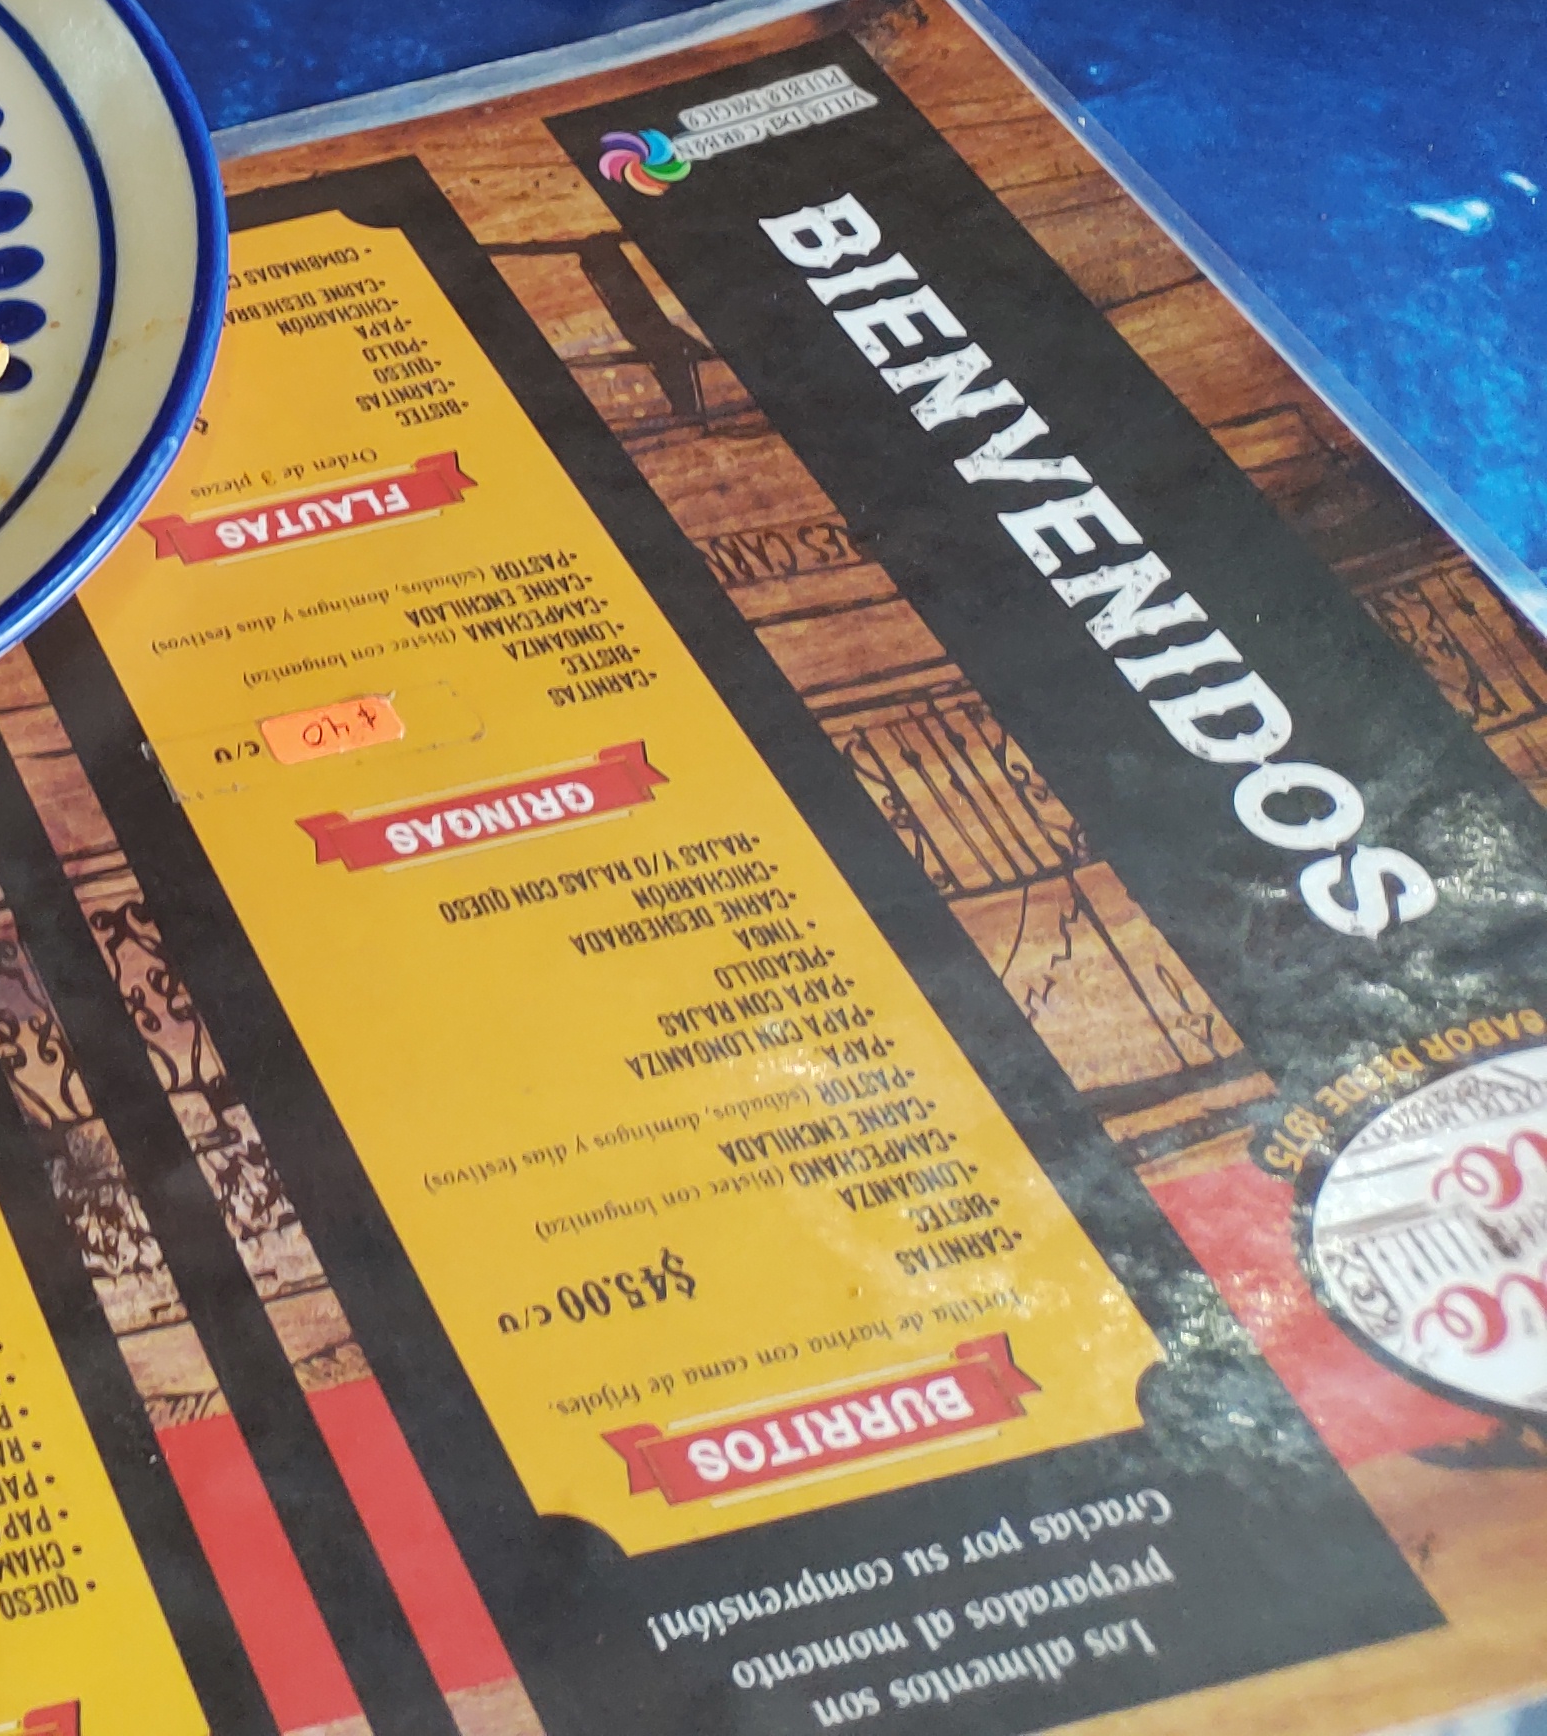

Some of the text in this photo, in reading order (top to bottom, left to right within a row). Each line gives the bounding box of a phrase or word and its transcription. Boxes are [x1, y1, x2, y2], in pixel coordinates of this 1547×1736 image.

[242, 247, 359, 284] COMBINADAS
[361, 336, 420, 362] POLLO
[372, 356, 434, 382] QUESO
[354, 378, 448, 411] CARNITAS
[394, 398, 461, 426] BISTEC
[215, 483, 409, 548] FLAUTAS
[491, 550, 569, 580] PASTOR
[758, 191, 1439, 938] BIENVENIDOS
[461, 596, 600, 641] CAMPECHANA
[546, 668, 649, 706] CARNITAS
[384, 781, 594, 854] GRINGAS
[438, 832, 752, 922] RAJAS Y/O RAJAS CON QUESO
[630, 860, 771, 910] CHICHARRÓN
[570, 888, 789, 955] CARNE DESHEBRADA
[733, 917, 800, 950] TINGA
[712, 945, 827, 989] PICADILLO
[656, 973, 847, 1036] PAPA CON RAJAS
[788, 1128, 949, 1185] CAMPECHANO
[661, 1186, 700, 1206] con
[555, 1247, 695, 1322] $45.00
[687, 1375, 973, 1481] BURRITOS
[646, 1489, 1171, 1651] Gracias por su comprensión!
[731, 1544, 1174, 1689] preparados al momento
[811, 1617, 1155, 1727] Los alimentos son
